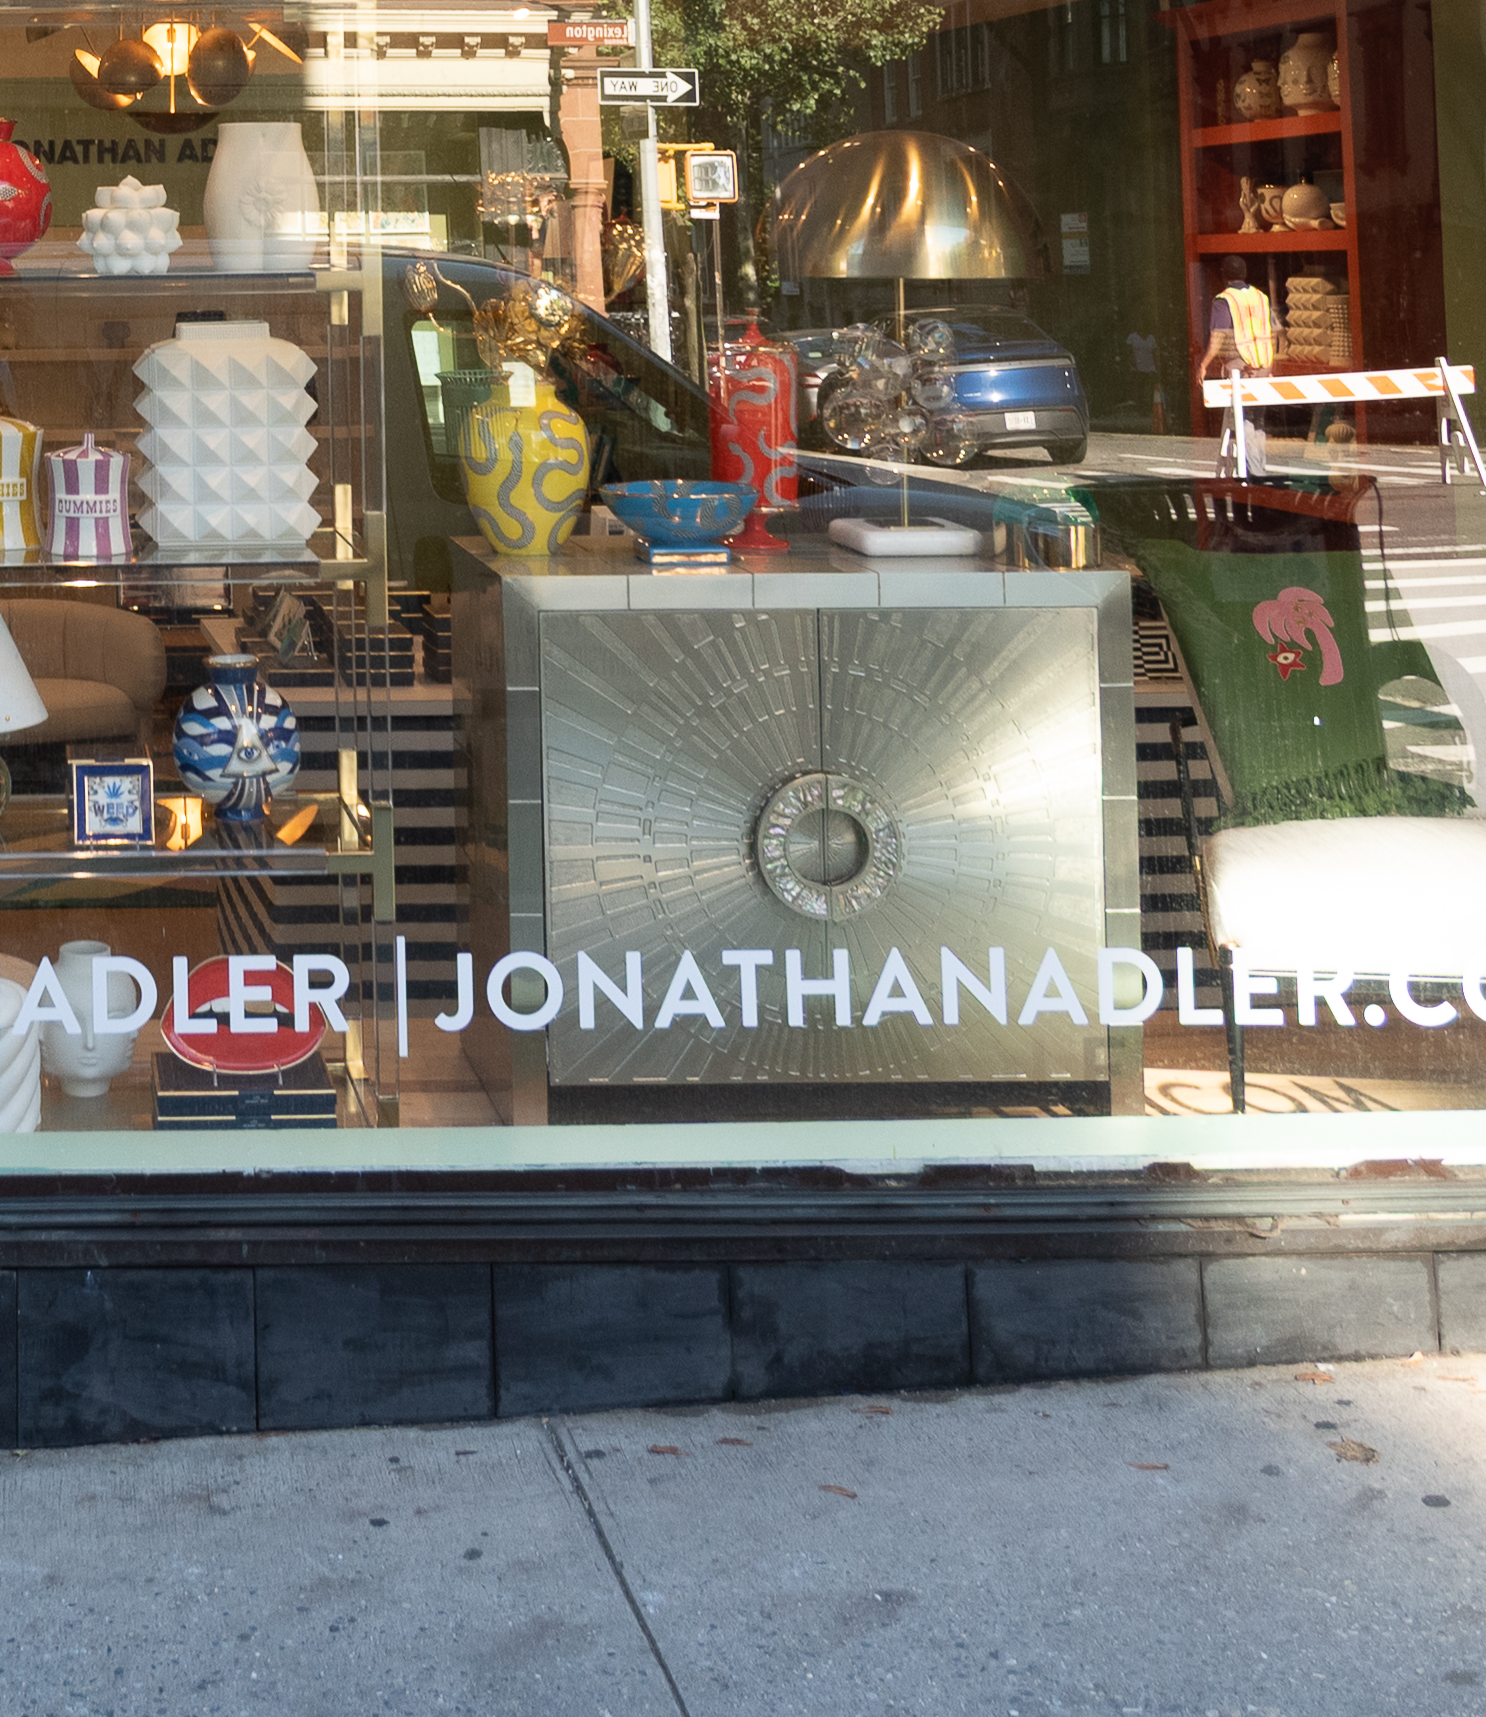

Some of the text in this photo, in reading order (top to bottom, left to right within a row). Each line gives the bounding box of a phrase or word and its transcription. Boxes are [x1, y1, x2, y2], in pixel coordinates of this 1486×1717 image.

[12, 138, 167, 165] NATHAN
[57, 498, 119, 514] GUMMIES
[93, 801, 138, 818] WEED
